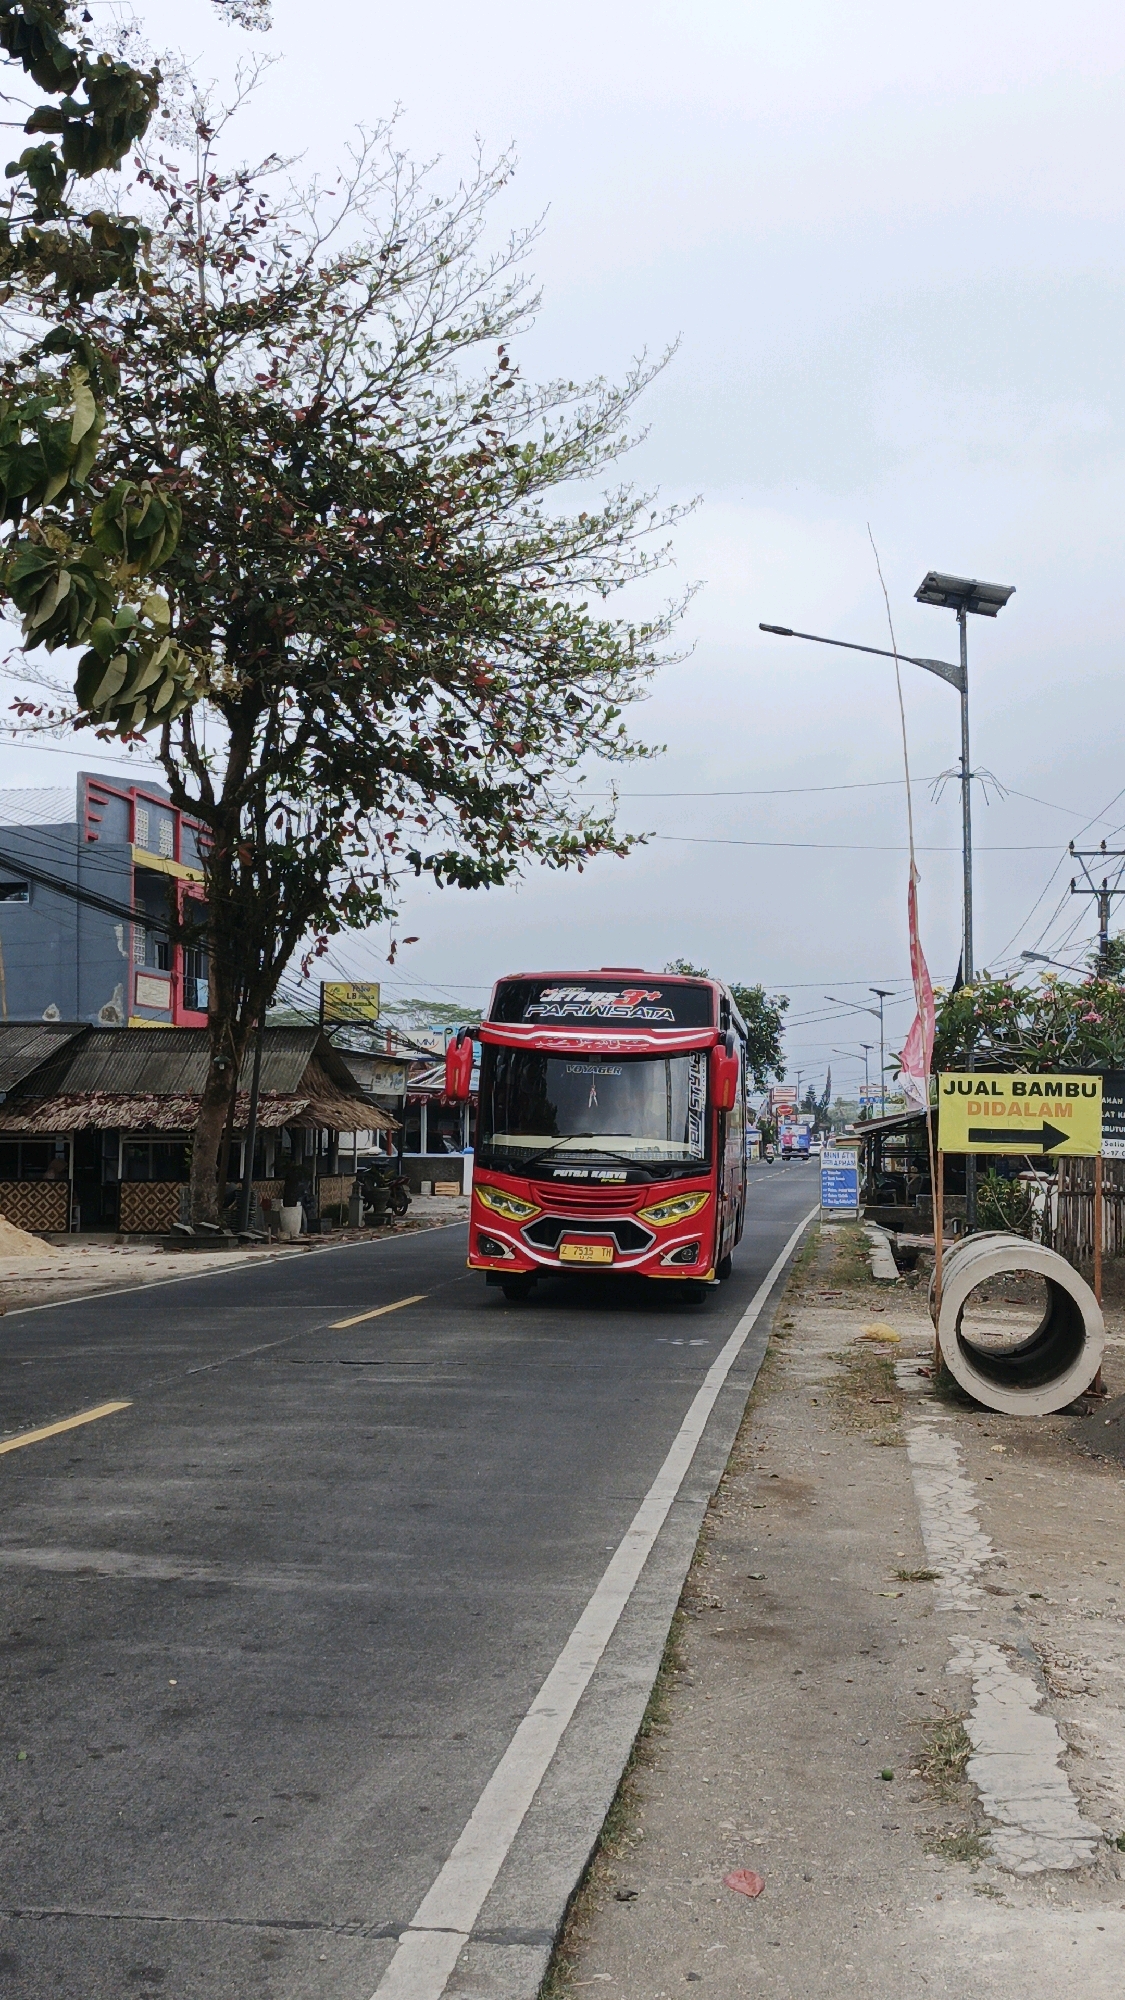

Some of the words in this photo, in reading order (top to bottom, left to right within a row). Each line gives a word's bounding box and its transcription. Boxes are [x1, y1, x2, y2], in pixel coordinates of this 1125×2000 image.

[523, 1003, 675, 1022] PARIWISATA
[566, 1064, 622, 1076] VOYAGER
[943, 1081, 1004, 1096] JUAL
[1012, 1081, 1097, 1098] BAMBU
[967, 1101, 1073, 1118] DIDALAM
[552, 1169, 589, 1178] PUTRA
[561, 1245, 568, 1255] Z
